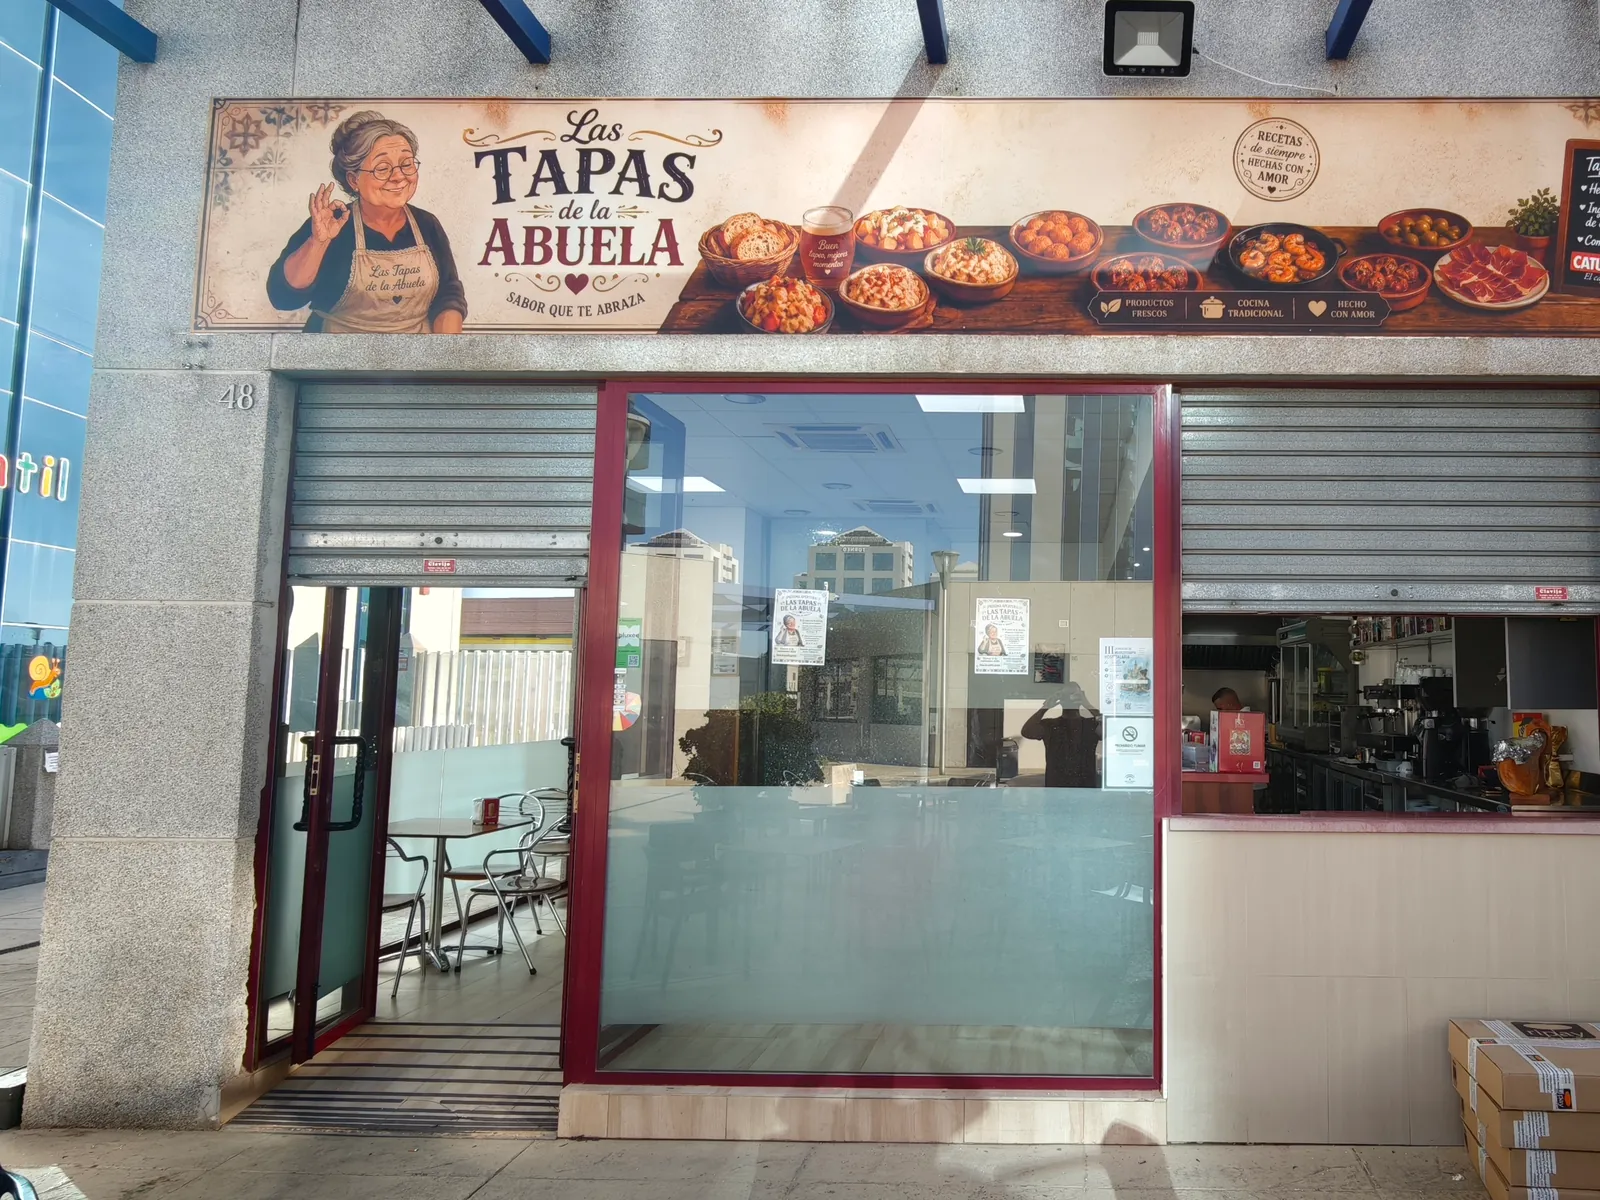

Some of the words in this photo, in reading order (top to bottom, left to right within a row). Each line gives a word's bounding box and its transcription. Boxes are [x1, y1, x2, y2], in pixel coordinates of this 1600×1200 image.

[560, 108, 624, 144] Las
[1258, 130, 1302, 146] RECETAS
[1250, 142, 1262, 153] de
[1265, 146, 1306, 162] siempre
[1248, 158, 1282, 170] HECHAS
[1286, 164, 1304, 174] CON
[1586, 156, 1600, 175] Ta
[474, 146, 696, 205] TAPAS
[1258, 171, 1288, 184] AMOR
[558, 199, 584, 220] de
[590, 199, 612, 220] la
[1585, 216, 1596, 228] de
[478, 218, 684, 266] ABUELA
[818, 240, 839, 250] Buen
[369, 264, 390, 278] Las
[392, 264, 420, 280] Tapas
[366, 280, 377, 292] de
[380, 280, 390, 291] la
[392, 276, 426, 291] Abuela
[506, 292, 546, 314] SABOR
[549, 304, 574, 318] QUE
[578, 305, 592, 317] TE
[596, 292, 646, 316] ABRAZA
[1126, 299, 1174, 307] PRODUCTOS
[1337, 300, 1367, 308] HECHO
[1330, 310, 1349, 318] CON
[1350, 310, 1375, 318] AMOR
[218, 384, 254, 410] 48
